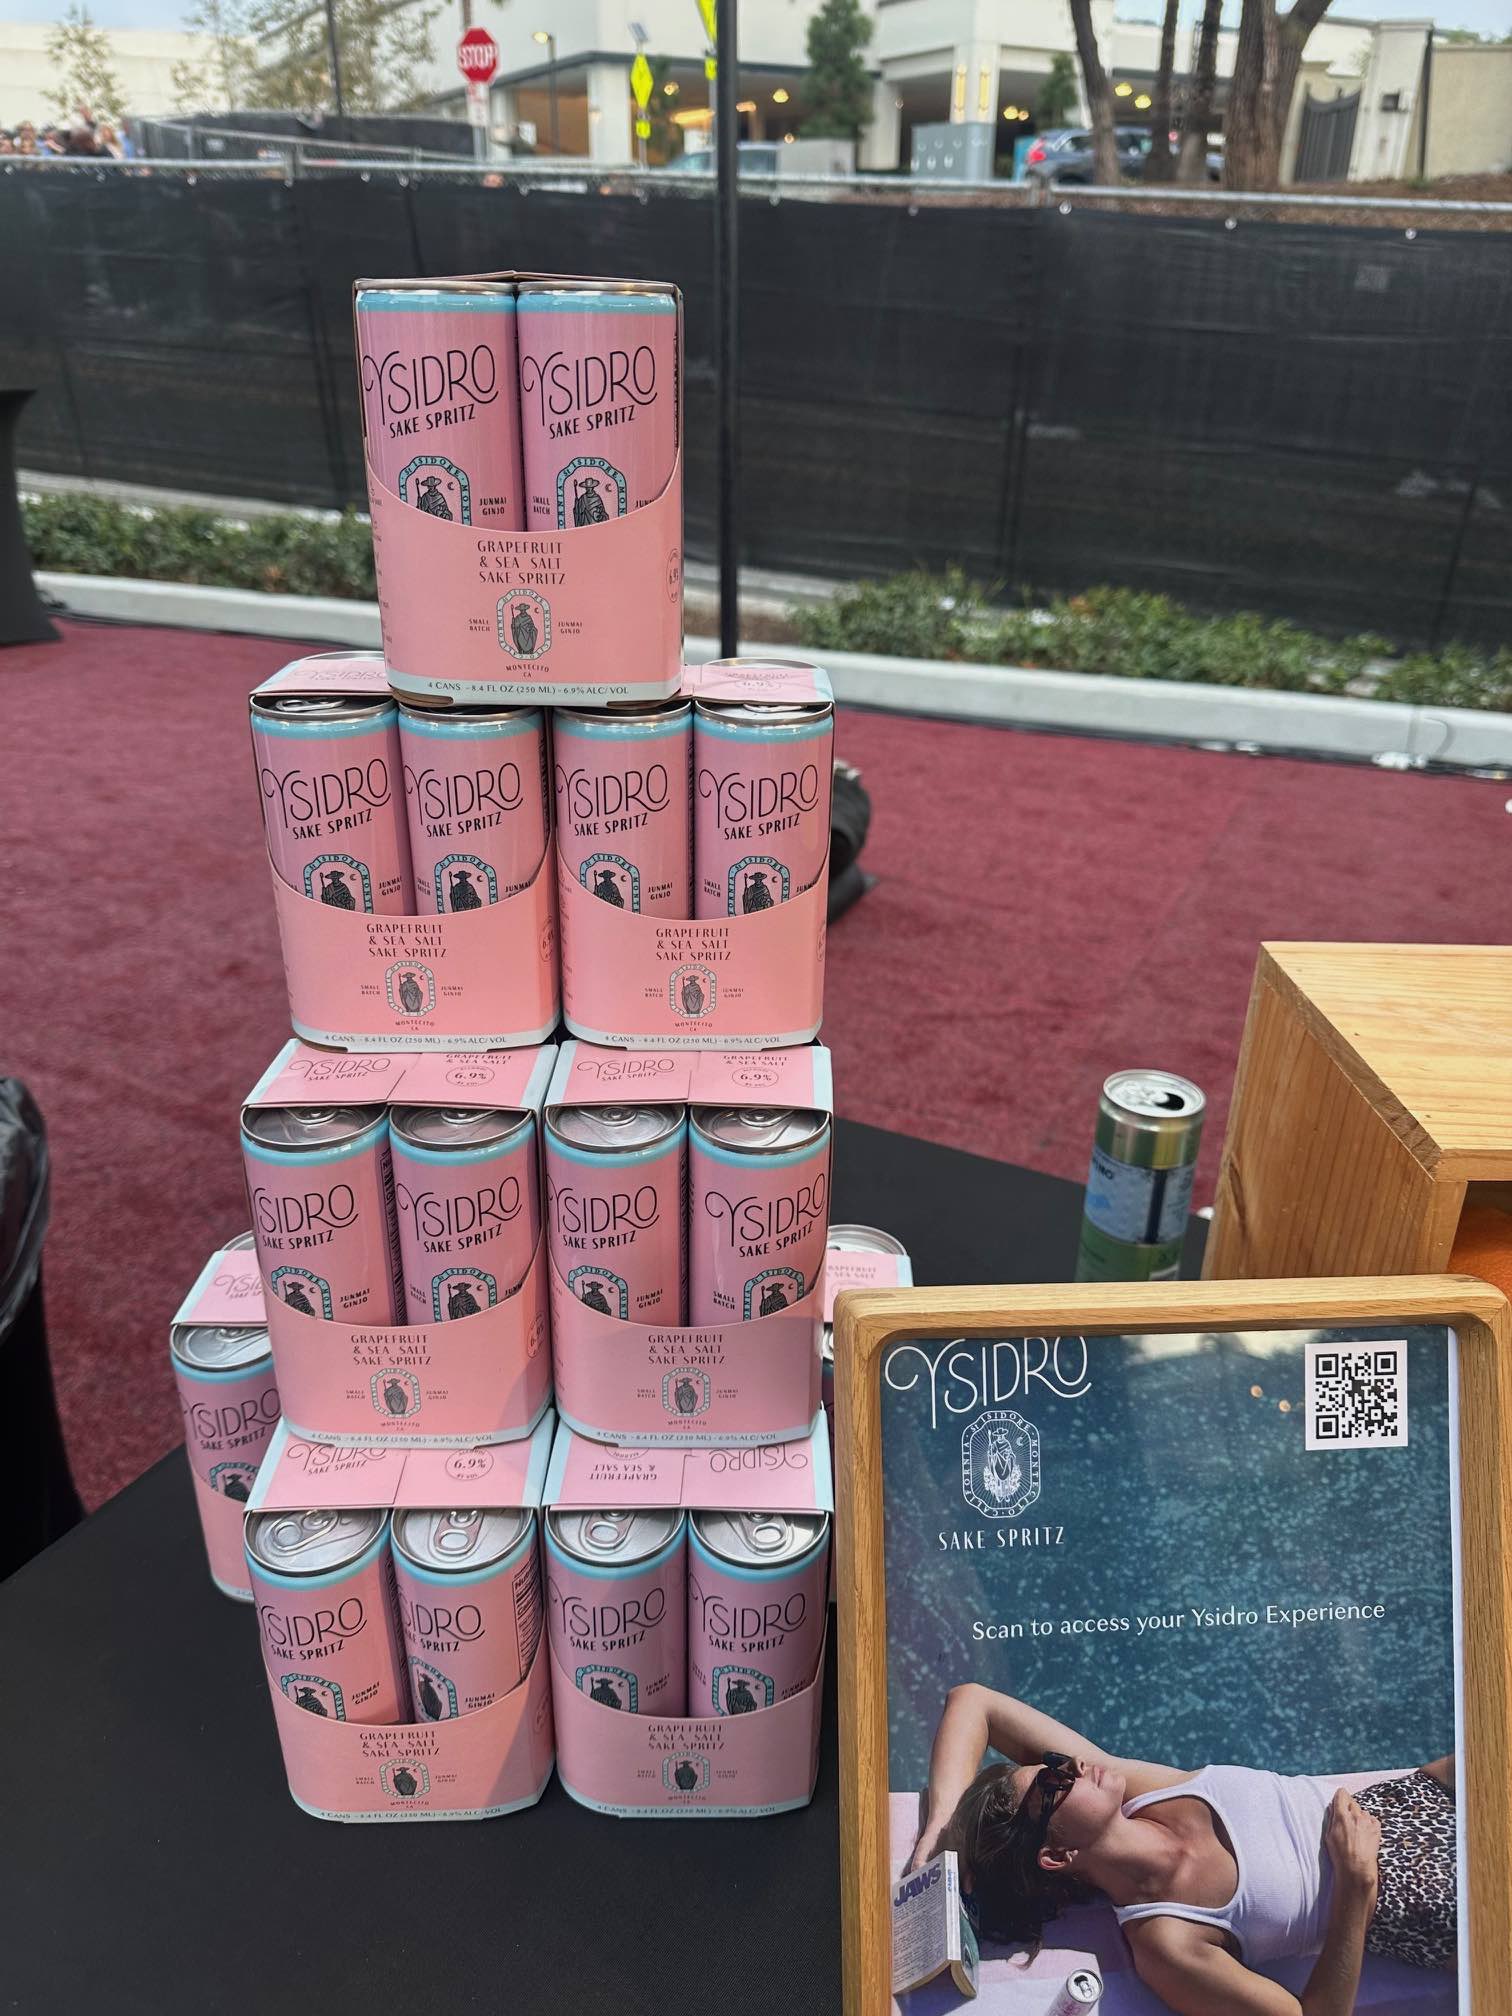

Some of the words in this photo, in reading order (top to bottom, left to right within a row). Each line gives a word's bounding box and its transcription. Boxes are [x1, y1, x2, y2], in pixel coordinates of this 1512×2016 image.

[458, 45, 497, 66] STOP
[362, 345, 499, 425] YSIDRO
[521, 346, 657, 426] YSIDRO
[389, 417, 420, 439] SAKE
[426, 403, 476, 430] SPRITZ
[549, 418, 580, 439] SAKE
[586, 405, 636, 431] SPRITZ
[412, 457, 461, 477] ISIDORE
[572, 458, 618, 478] ISIDORE
[479, 497, 508, 507] JUNMAI
[532, 497, 550, 506] SMALL
[482, 507, 505, 516] GINJO
[533, 507, 551, 515] BATCH
[477, 540, 564, 554] GRAPEFRUIT
[480, 556, 488, 568] &
[496, 556, 520, 569] SEA
[531, 557, 562, 569] SALT
[479, 571, 513, 583] SAKE
[519, 572, 566, 585] SPRITZ
[505, 664, 550, 673] MONTECITO
[436, 681, 461, 690] CANS
[487, 684, 498, 692] FL
[500, 685, 514, 693] OZ
[516, 685, 534, 694] (250
[538, 685, 555, 694] ML)
[563, 686, 585, 694] 6.9%
[261, 758, 391, 829] YSIDRO
[404, 762, 524, 826] YSIDRO
[555, 764, 670, 825] YSIDRO
[697, 764, 819, 829] YSIDRO
[292, 823, 323, 840] SAKE
[327, 808, 373, 834] SPRITZ
[426, 823, 452, 838] SAKE
[457, 811, 503, 834] SPRITZ
[574, 823, 599, 837] SAKE
[604, 812, 648, 834] SPRITZ
[724, 826, 752, 840] SAKE
[757, 812, 801, 837] SPRITZ
[381, 884, 401, 896] GINJO
[647, 882, 673, 893] JUNMAI
[704, 879, 721, 890] SMALL
[650, 891, 671, 900] GINJO
[366, 923, 443, 934] GRAPEFRUIT
[656, 927, 730, 938] GRAPEFRUIT
[369, 935, 377, 945] &
[383, 935, 405, 946] SEA
[414, 936, 443, 946] SALT
[657, 939, 664, 949] &
[672, 939, 692, 949] SEA
[702, 939, 728, 949] SALT
[368, 947, 400, 957] SAKE
[404, 948, 447, 958] SPRITZ
[656, 951, 686, 960] SAKE
[690, 951, 732, 961] SPRITZ
[288, 1058, 391, 1079] YSIDRO
[335, 1071, 368, 1080] SPRITZ
[576, 1058, 676, 1079] YSIDRO
[626, 1071, 657, 1080] SPRITZ
[454, 1072, 487, 1080] 6.9%
[739, 1073, 772, 1082] 6.9%
[396, 1176, 523, 1241] YSIDRO
[704, 1172, 826, 1247] YSIDRO
[262, 1234, 286, 1250] SAKE
[289, 1230, 334, 1250] SPRITZ
[424, 1240, 452, 1254] SAKE
[458, 1222, 503, 1250] SPRITZ
[562, 1234, 587, 1250] SAKE
[592, 1230, 636, 1249] SPRITZ
[739, 1245, 770, 1258] SAKE
[776, 1221, 814, 1250] SPRITZ
[339, 1287, 371, 1302] JUNMAI
[636, 1289, 663, 1302] JUNMAI
[713, 1290, 736, 1303] SMALL
[343, 1296, 368, 1308] GINJO
[351, 1334, 428, 1345] GRAPEFRUIT
[648, 1334, 723, 1344] GRAPEFRUIT
[353, 1345, 361, 1355] &
[368, 1345, 390, 1355] SEA
[399, 1345, 428, 1355] SALT
[649, 1345, 657, 1354] &
[663, 1345, 685, 1354] SEA
[695, 1345, 723, 1354] SALT
[353, 1356, 386, 1366] SAKE
[388, 1356, 432, 1366] SPRITZ
[648, 1355, 677, 1365] SAKE
[683, 1355, 726, 1365] SPRITZ
[884, 1336, 1092, 1429] YSIDRO
[981, 1411, 1031, 1433] ISIDORE
[200, 1440, 224, 1450] SAKE
[227, 1427, 265, 1448] SPRITZ
[308, 1466, 331, 1474] SAKE
[335, 1459, 368, 1471] SPRITZ
[453, 1457, 487, 1470] 6.9%
[938, 1530, 986, 1551] SAKE
[996, 1526, 1065, 1548] SPRITZ
[548, 1576, 667, 1637] YSIDRO
[689, 1572, 807, 1639] YSIDRO
[971, 1620, 1024, 1640] Scan
[1030, 1619, 1053, 1637] to
[1059, 1617, 1130, 1634] access
[1137, 1614, 1185, 1641] your
[1191, 1606, 1259, 1628] Ysidro
[1265, 1601, 1386, 1627] Experience
[420, 1638, 460, 1652] SPRITZ
[569, 1636, 596, 1651] SAKE
[602, 1630, 646, 1651] SPRITZ
[709, 1634, 735, 1652] SAKE
[741, 1634, 785, 1653] SPRITZ
[271, 1644, 297, 1660] SAKE
[299, 1639, 345, 1660] SPRITZ
[360, 1731, 436, 1740] GRAPEFRUIT
[376, 1740, 398, 1748] SEA
[408, 1740, 436, 1748] SALT
[362, 1748, 393, 1757] SAKE
[397, 1748, 440, 1757] SPRITZ
[893, 1863, 943, 1908] JAWS
